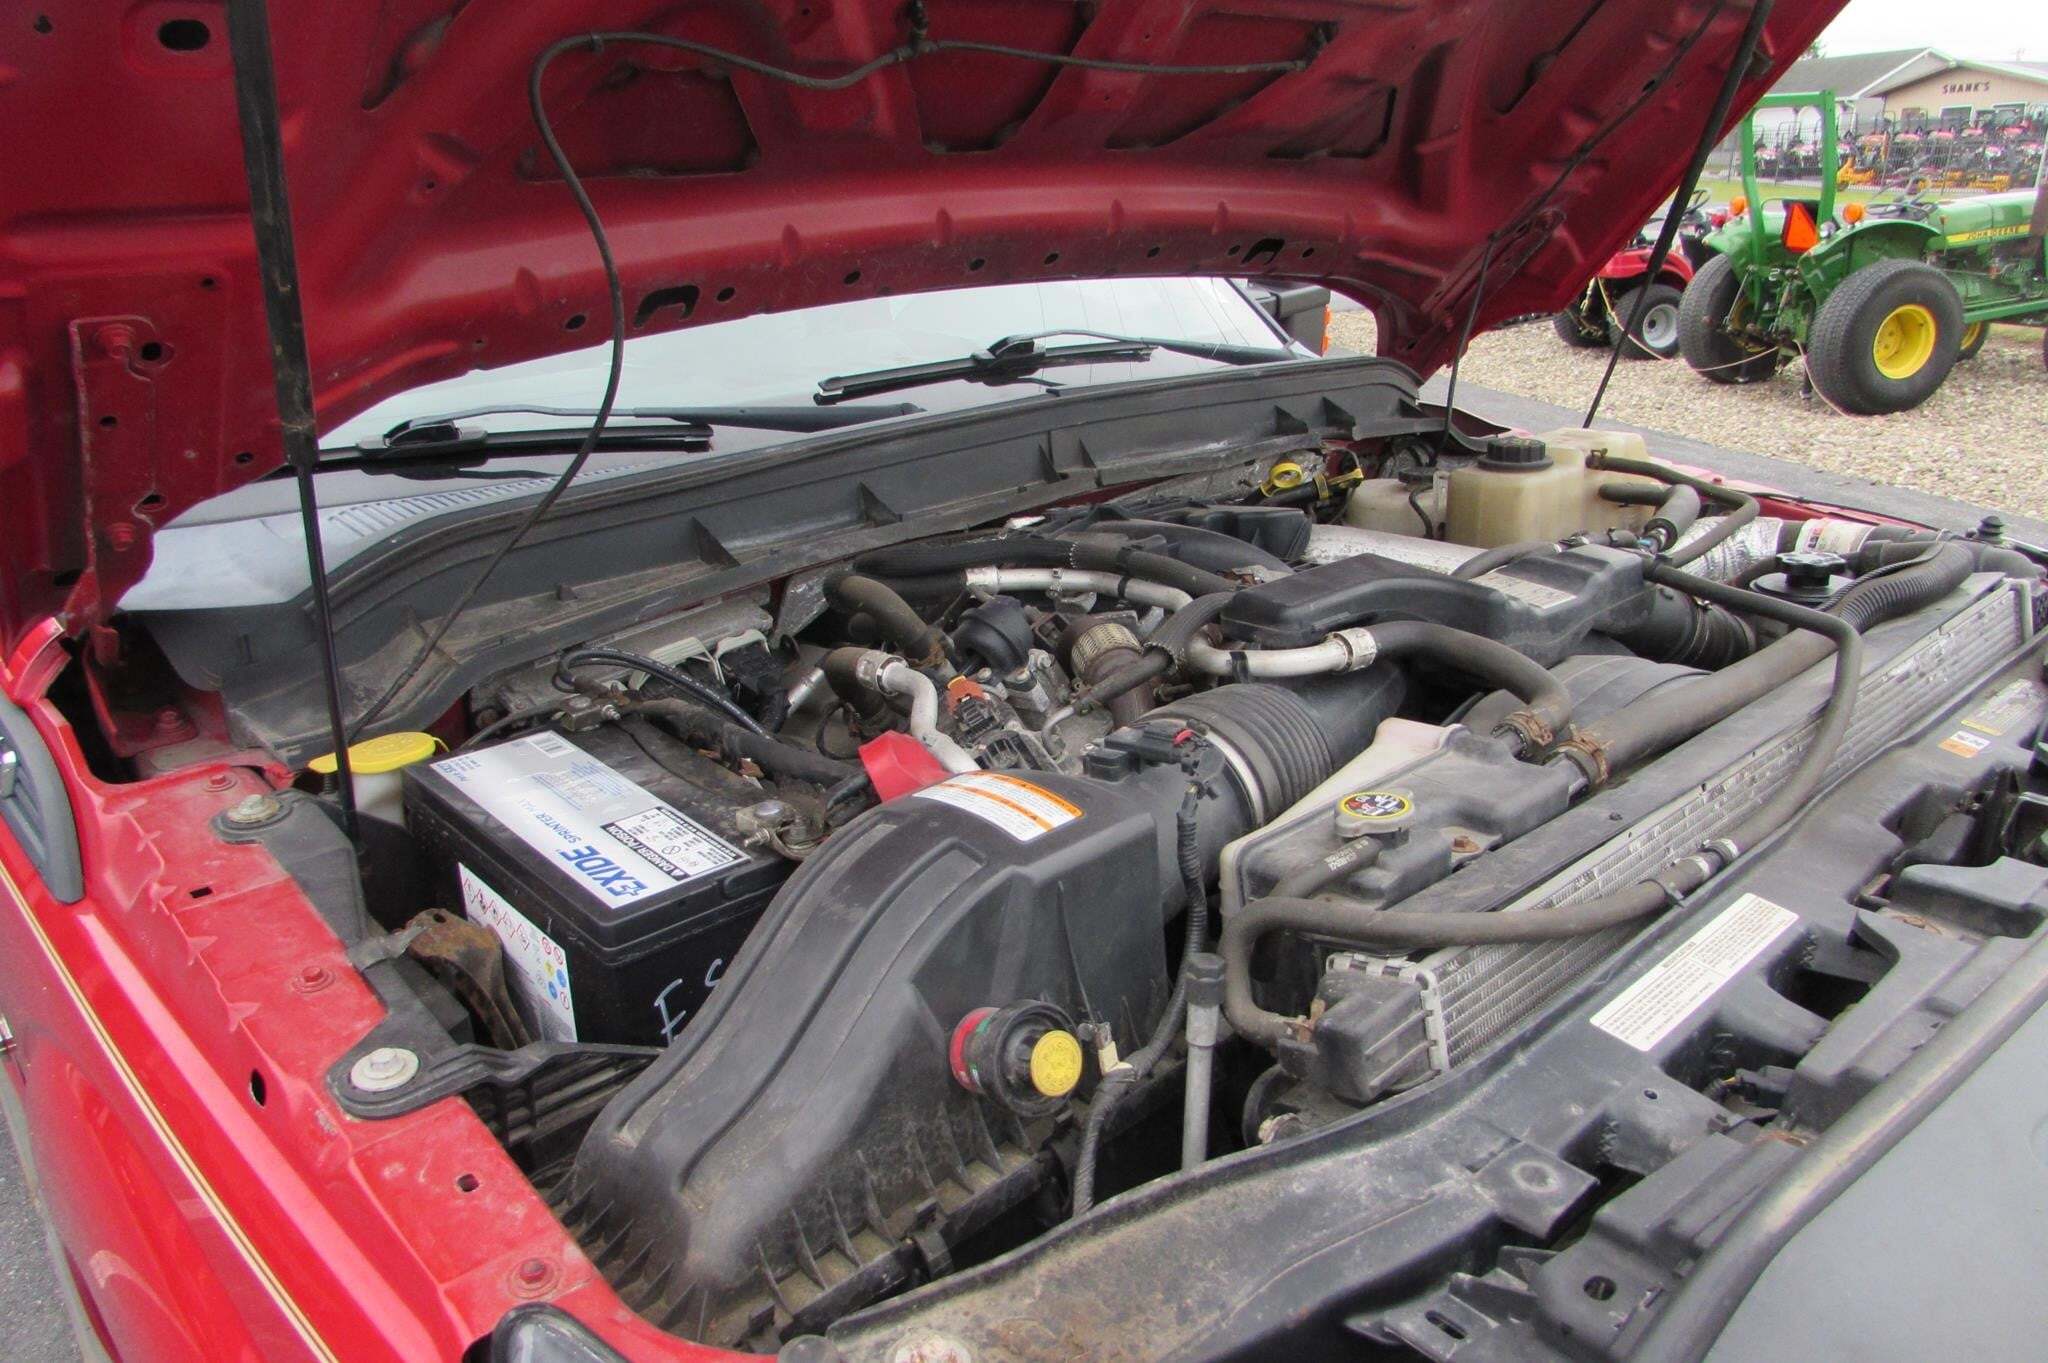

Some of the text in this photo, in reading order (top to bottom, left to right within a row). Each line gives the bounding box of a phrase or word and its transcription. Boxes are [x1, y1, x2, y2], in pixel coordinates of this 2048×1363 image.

[1943, 80, 1991, 95] SHANK'S
[536, 812, 582, 844] SPRINTER
[559, 845, 648, 897] EXIDE
